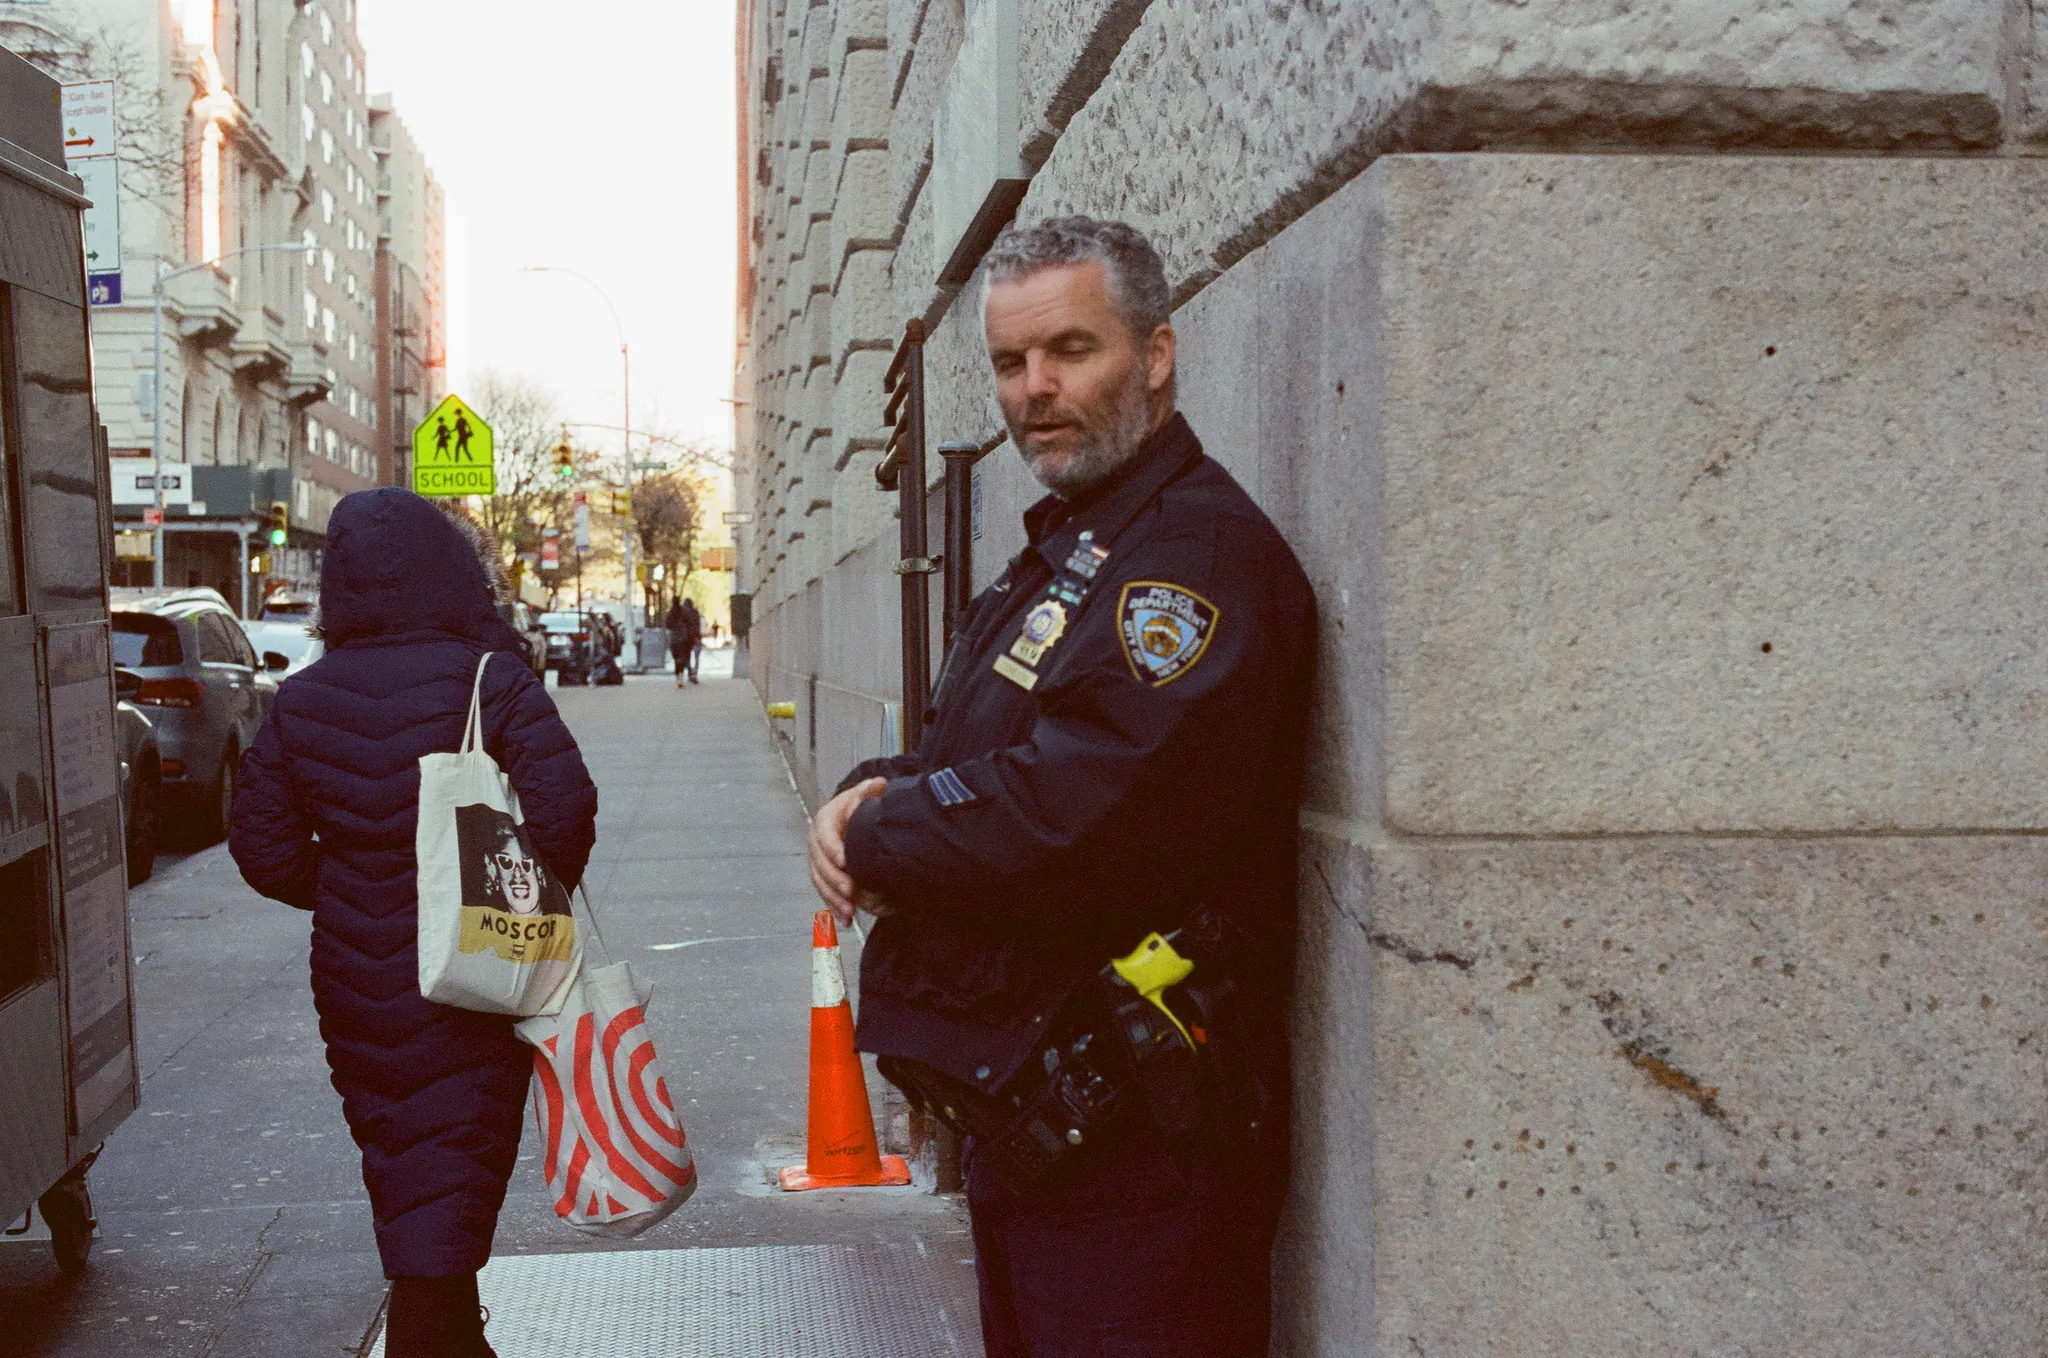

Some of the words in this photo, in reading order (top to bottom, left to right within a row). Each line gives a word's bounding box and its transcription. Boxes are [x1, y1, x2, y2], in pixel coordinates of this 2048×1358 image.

[420, 471, 489, 487] SCHOOL
[1148, 587, 1195, 610] POLICE
[1128, 597, 1208, 631] DEPARTMENT
[1123, 620, 1137, 645] CITY
[1157, 661, 1180, 678] NEW
[1180, 637, 1203, 662] YORK
